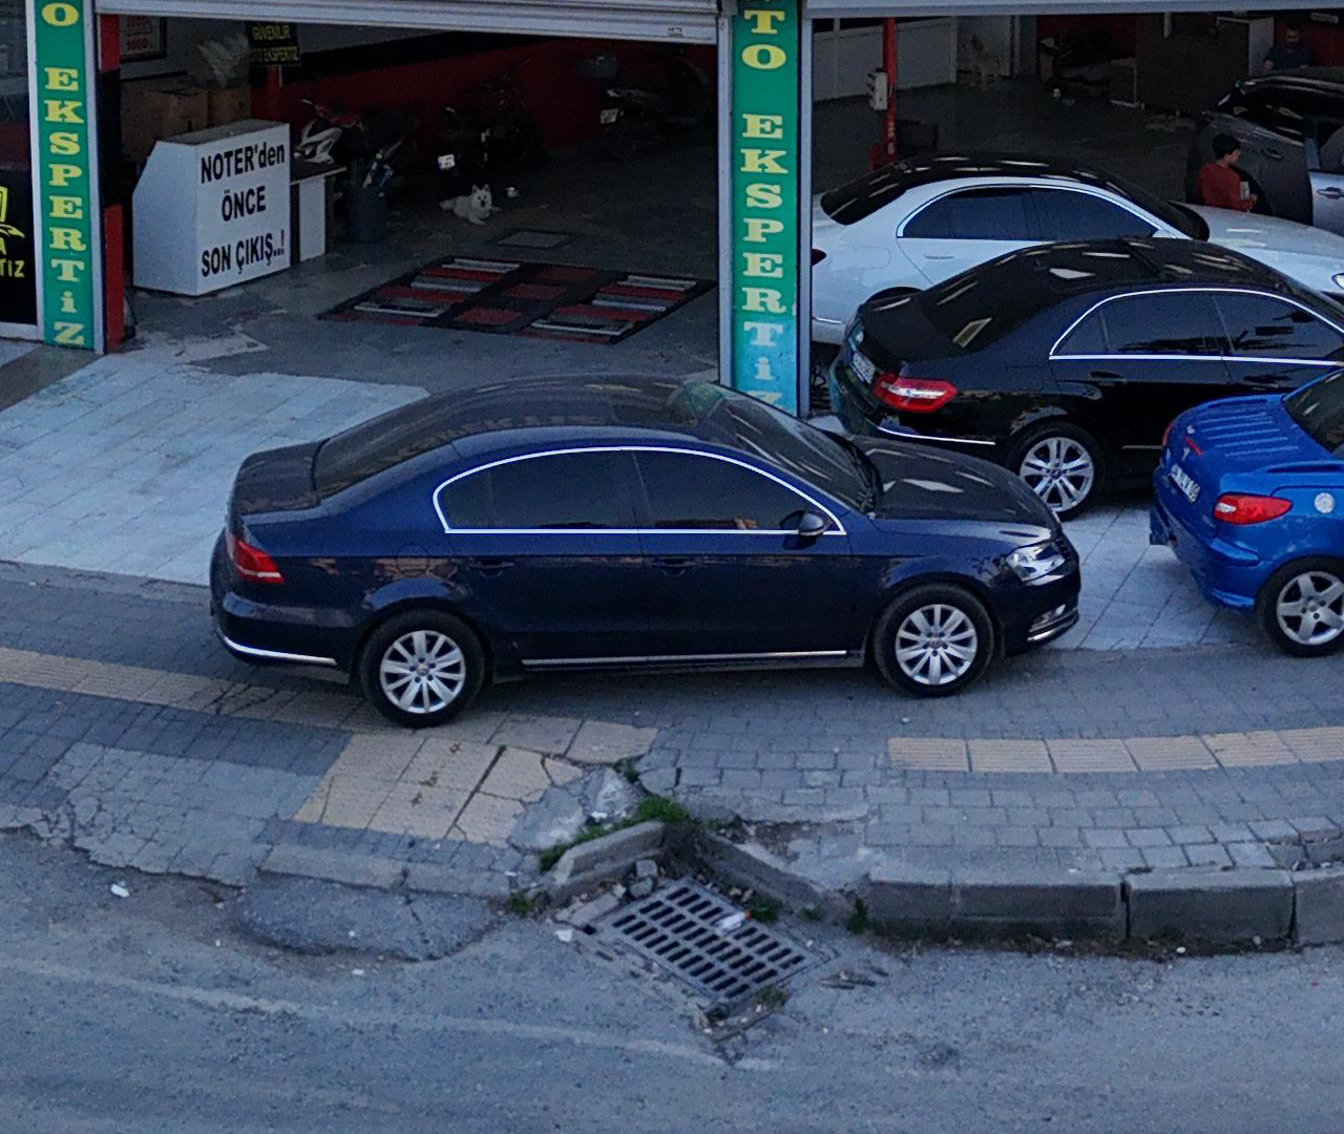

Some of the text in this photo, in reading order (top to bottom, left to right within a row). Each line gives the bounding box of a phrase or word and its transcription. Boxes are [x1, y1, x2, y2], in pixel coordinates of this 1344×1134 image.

[200, 141, 285, 184] NOTER'den
[221, 185, 267, 222] ÖNCE
[201, 243, 231, 277] SON
